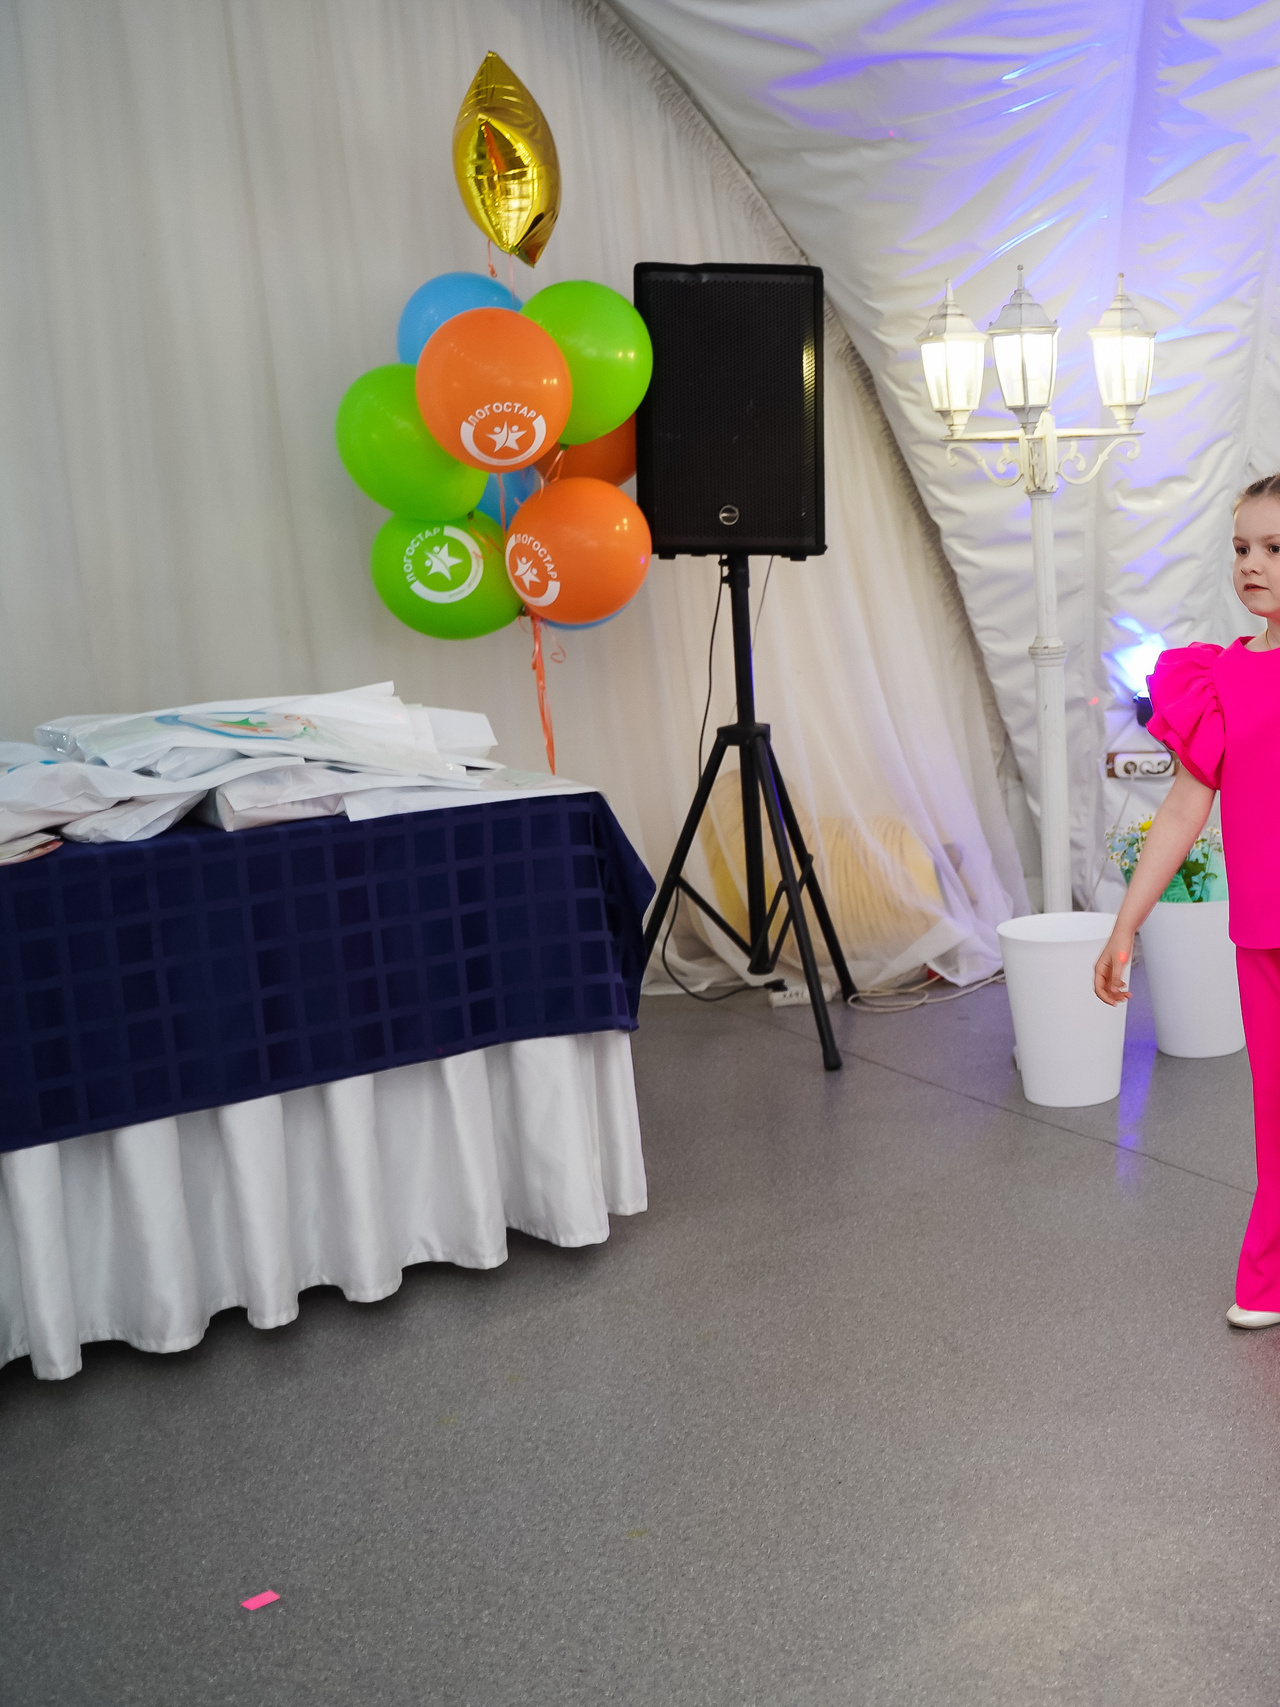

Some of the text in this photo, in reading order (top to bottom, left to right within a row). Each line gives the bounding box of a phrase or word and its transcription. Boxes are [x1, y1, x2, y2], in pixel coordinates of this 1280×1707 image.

[467, 401, 537, 427] ЛОГОСТАР
[403, 527, 441, 583] ЛОГОСТАР
[514, 533, 558, 579] ЛОГОСТАР
